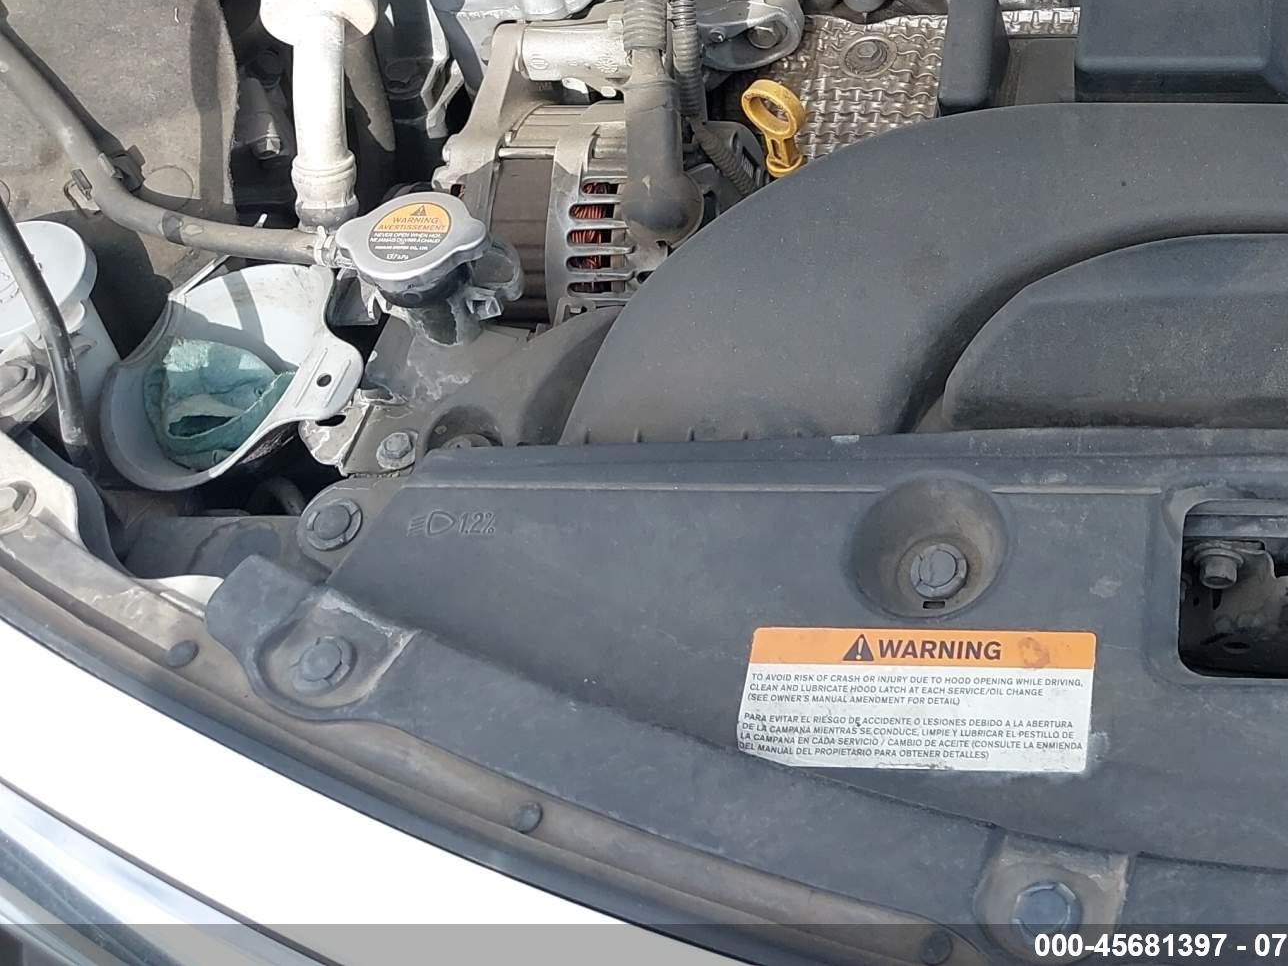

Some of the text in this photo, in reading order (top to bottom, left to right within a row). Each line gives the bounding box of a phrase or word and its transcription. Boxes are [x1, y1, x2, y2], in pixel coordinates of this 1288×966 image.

[460, 512, 496, 535] 1.2%
[878, 639, 1002, 660] WARNING
[863, 675, 874, 683] OR
[780, 684, 798, 692] AND
[812, 695, 847, 703] MANUAL
[850, 696, 904, 704] AMENDMENT
[744, 713, 766, 722] PARA
[813, 716, 846, 724] RIESGO
[862, 717, 911, 725] ACCIDENTE
[923, 718, 966, 726] LESIONES
[969, 719, 1002, 727] DEBIDO
[1026, 720, 1072, 728] ABERTURA
[742, 722, 753, 730] DE
[813, 727, 857, 735] MIENTRAS
[922, 729, 949, 737] LIMPIE
[1019, 731, 1059, 739] PESTILLO
[754, 734, 795, 744] CAMPANA
[812, 737, 836, 745] CADA
[888, 738, 922, 747] CAMBIO
[939, 740, 969, 748] ACEITE
[971, 740, 1020, 749] (CONSULTE
[1036, 741, 1082, 750] ENMIENDA
[739, 742, 755, 750] DEL
[758, 745, 793, 755] MANUAL
[815, 748, 871, 756] PROPIETARIO
[875, 749, 896, 757] PARA
[899, 749, 940, 758] OBTENER
[943, 750, 989, 759] DETALLES)
